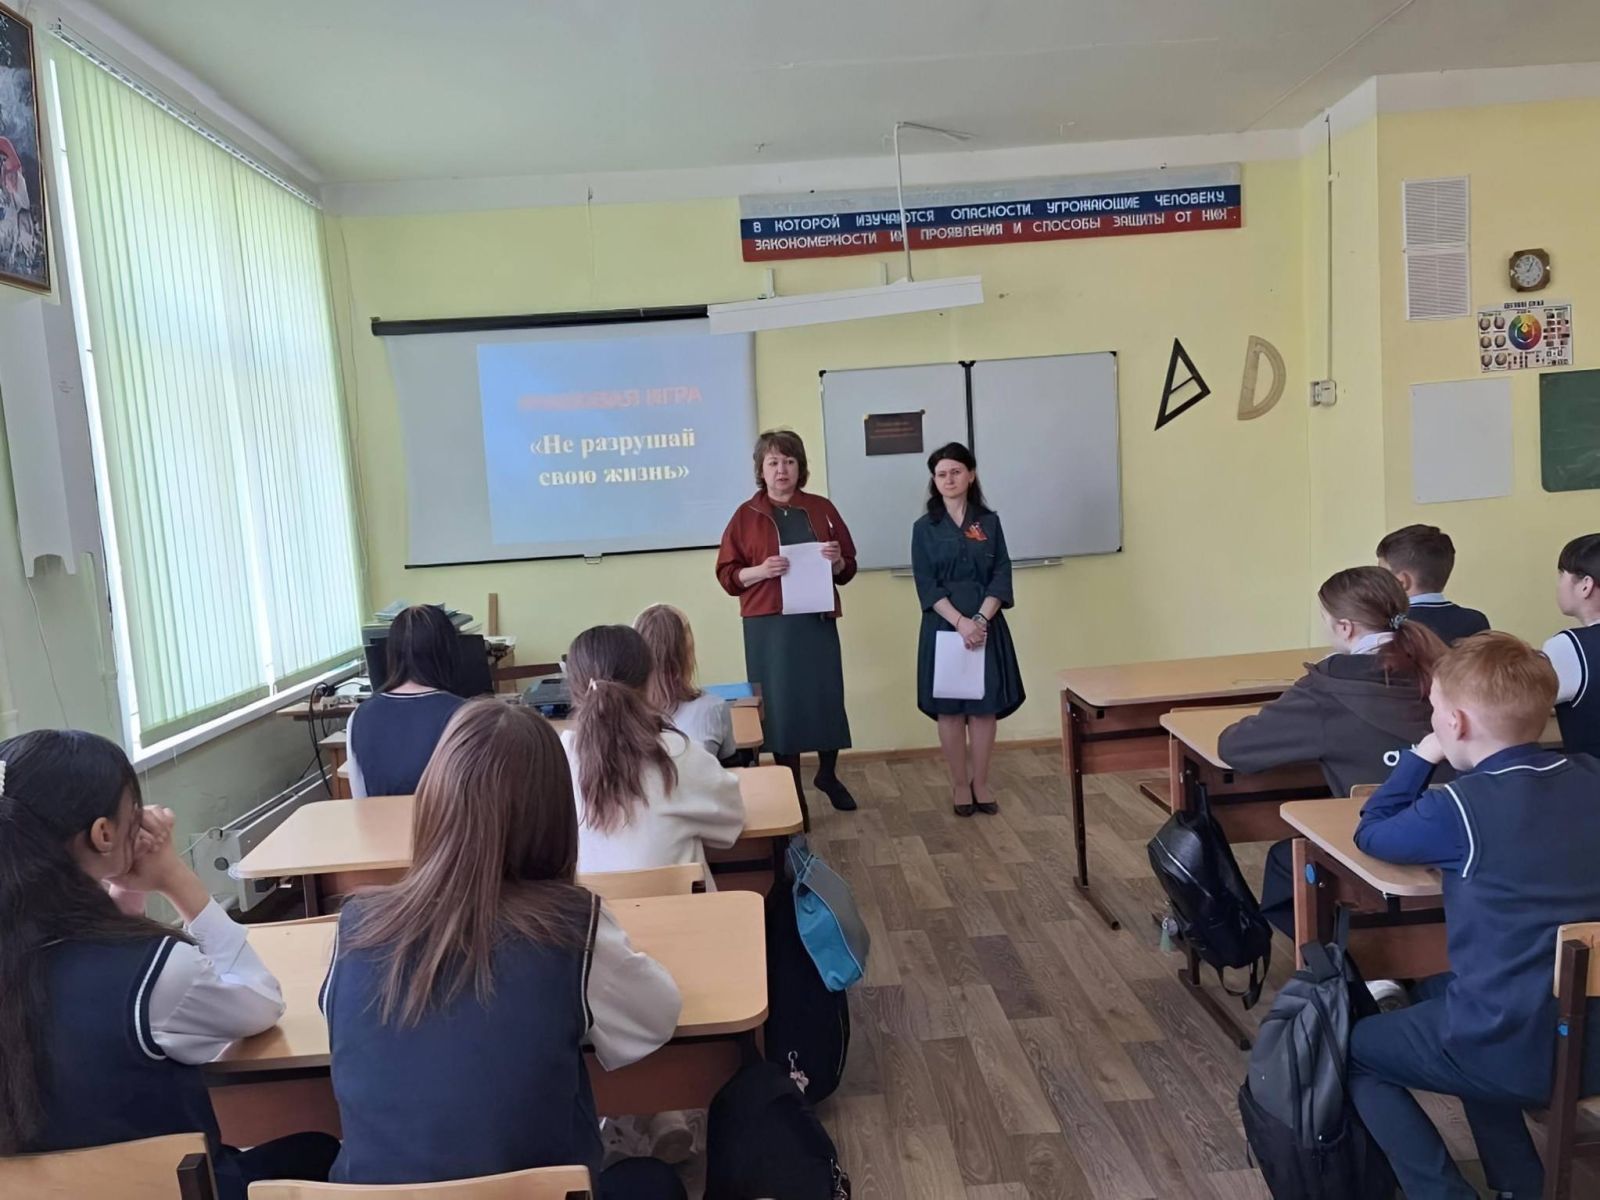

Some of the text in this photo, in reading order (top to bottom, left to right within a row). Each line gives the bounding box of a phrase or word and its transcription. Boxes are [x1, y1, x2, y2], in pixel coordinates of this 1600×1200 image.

[753, 221, 762, 233] В
[774, 214, 841, 232] КОТОРОЙ
[1046, 196, 1140, 213] УГРОЖАЮЩИЕ
[754, 231, 877, 251] ЗАКОНОМЕРНОСТИ
[920, 222, 1003, 241] ПРОЯВЛЕНИЯ
[1013, 221, 1022, 234] И
[1032, 217, 1101, 233] СПОСОБЫ
[1113, 212, 1165, 227] ЗАЩИТЫ
[1174, 210, 1192, 223] ОТ
[530, 428, 696, 459] «Не разрушай
[539, 465, 690, 487] свою жизнь»
